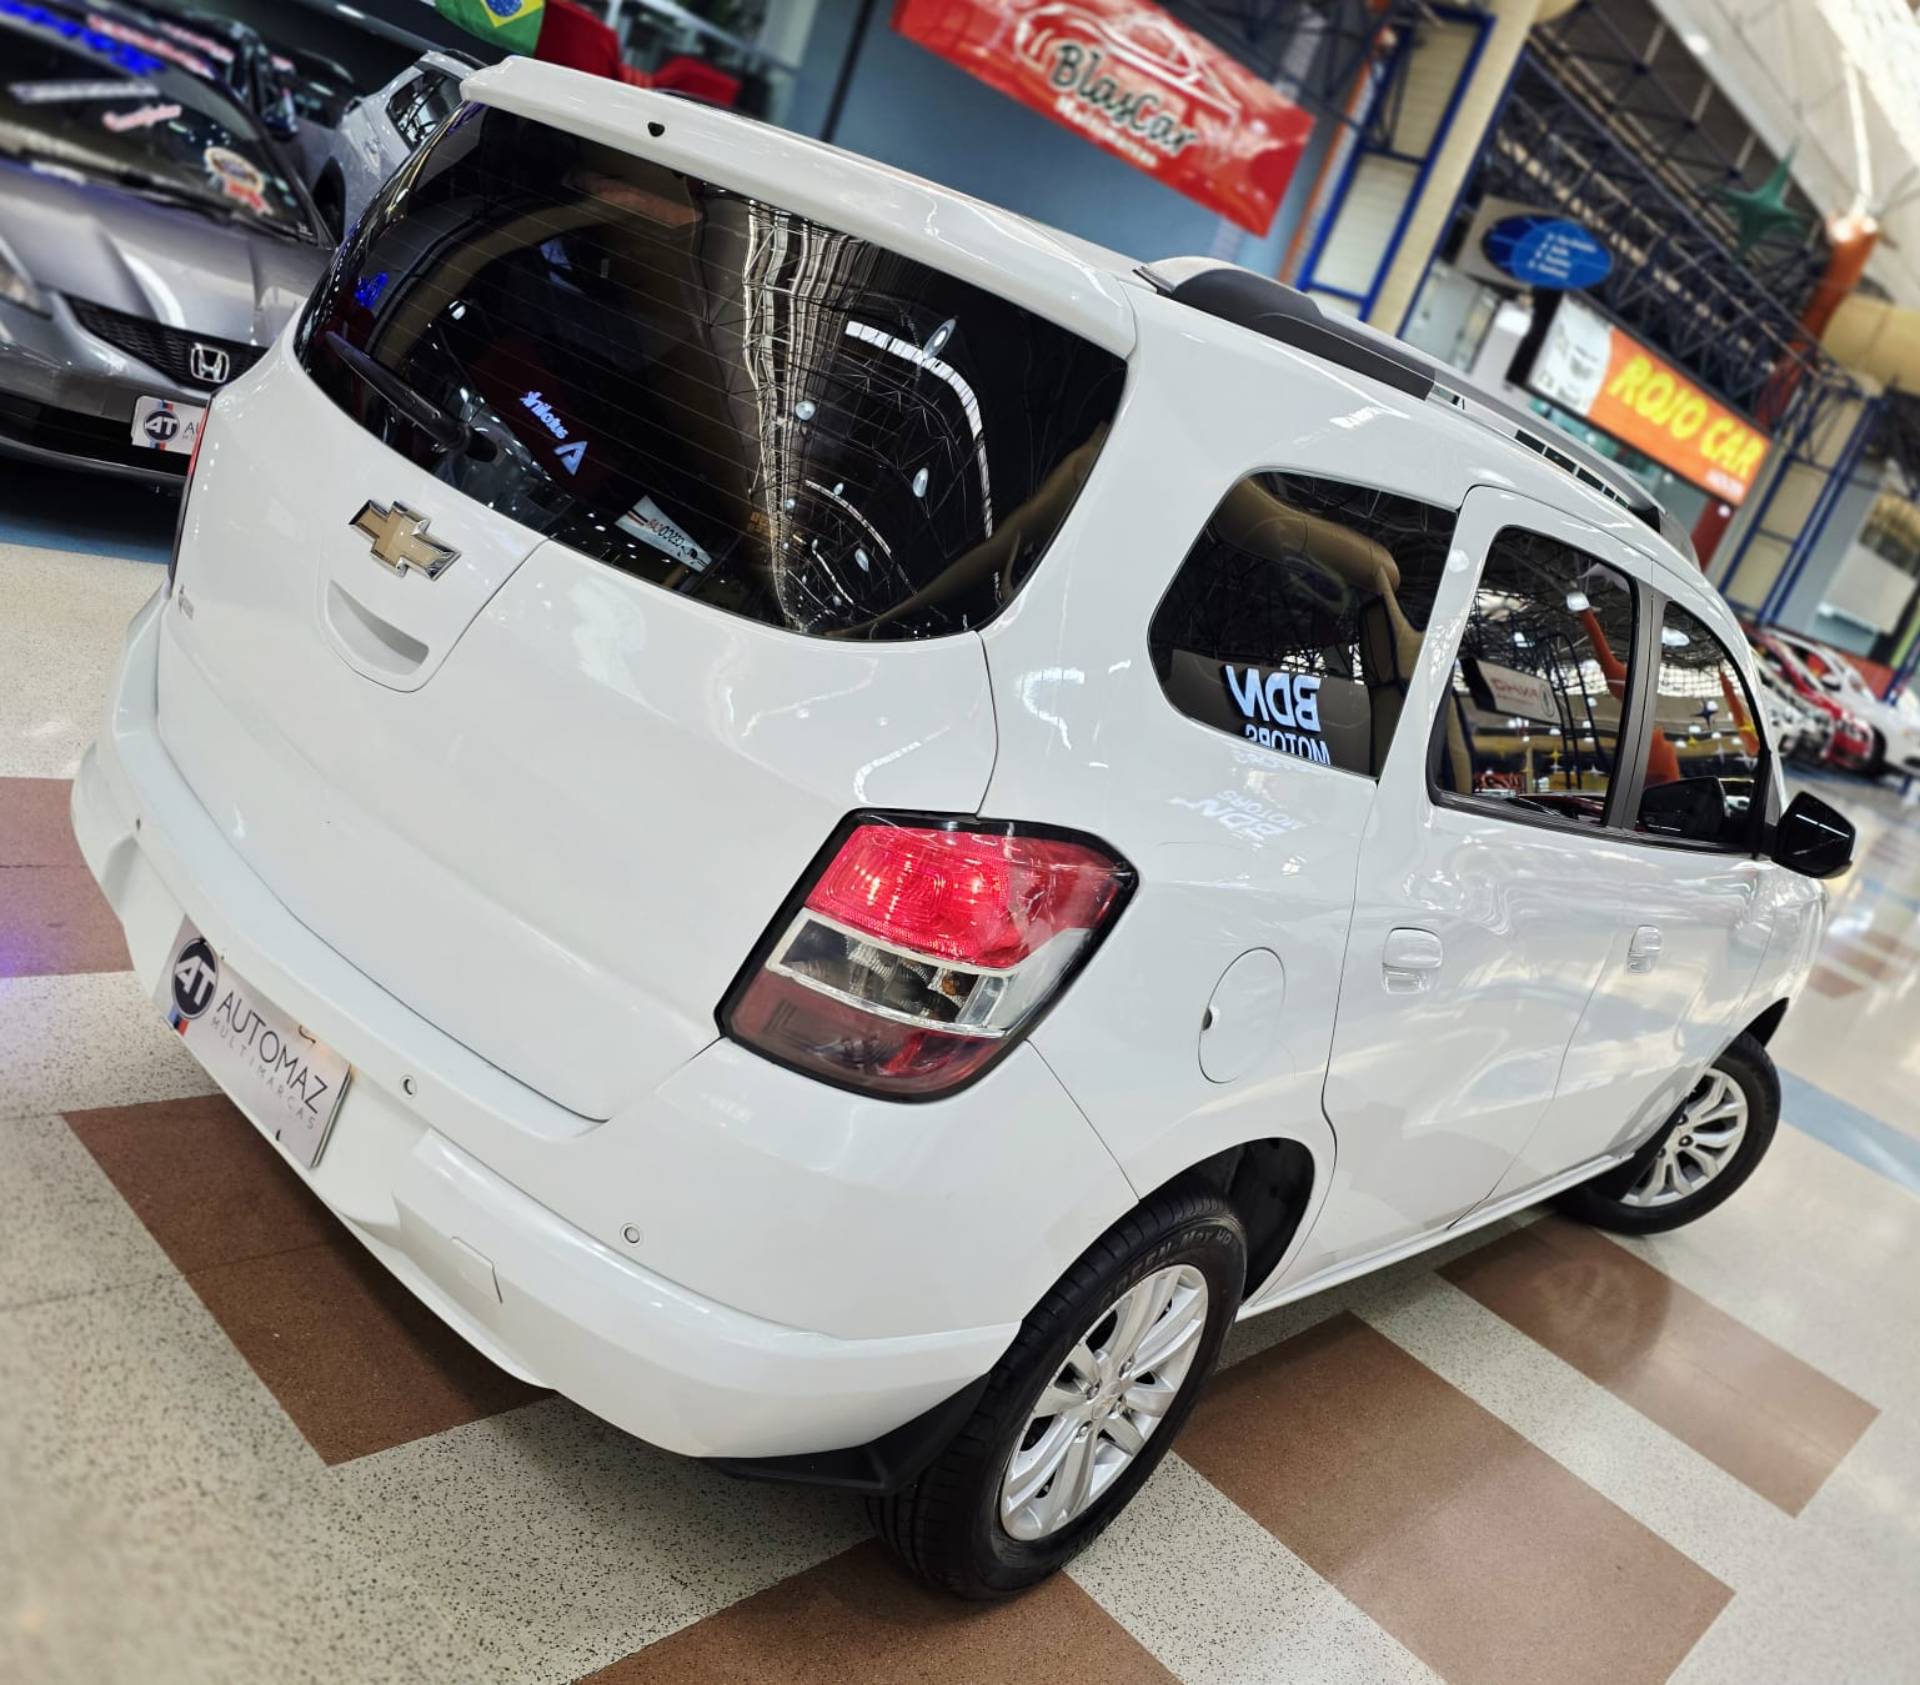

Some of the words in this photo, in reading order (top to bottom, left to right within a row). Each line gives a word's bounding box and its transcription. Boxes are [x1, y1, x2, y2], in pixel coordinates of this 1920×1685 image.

[1049, 38, 1200, 156] BlasCar
[1608, 356, 1708, 440] ROJO
[1703, 417, 1767, 478] CAR
[175, 955, 217, 1006] AT
[217, 992, 329, 1115] AUTOMAZ
